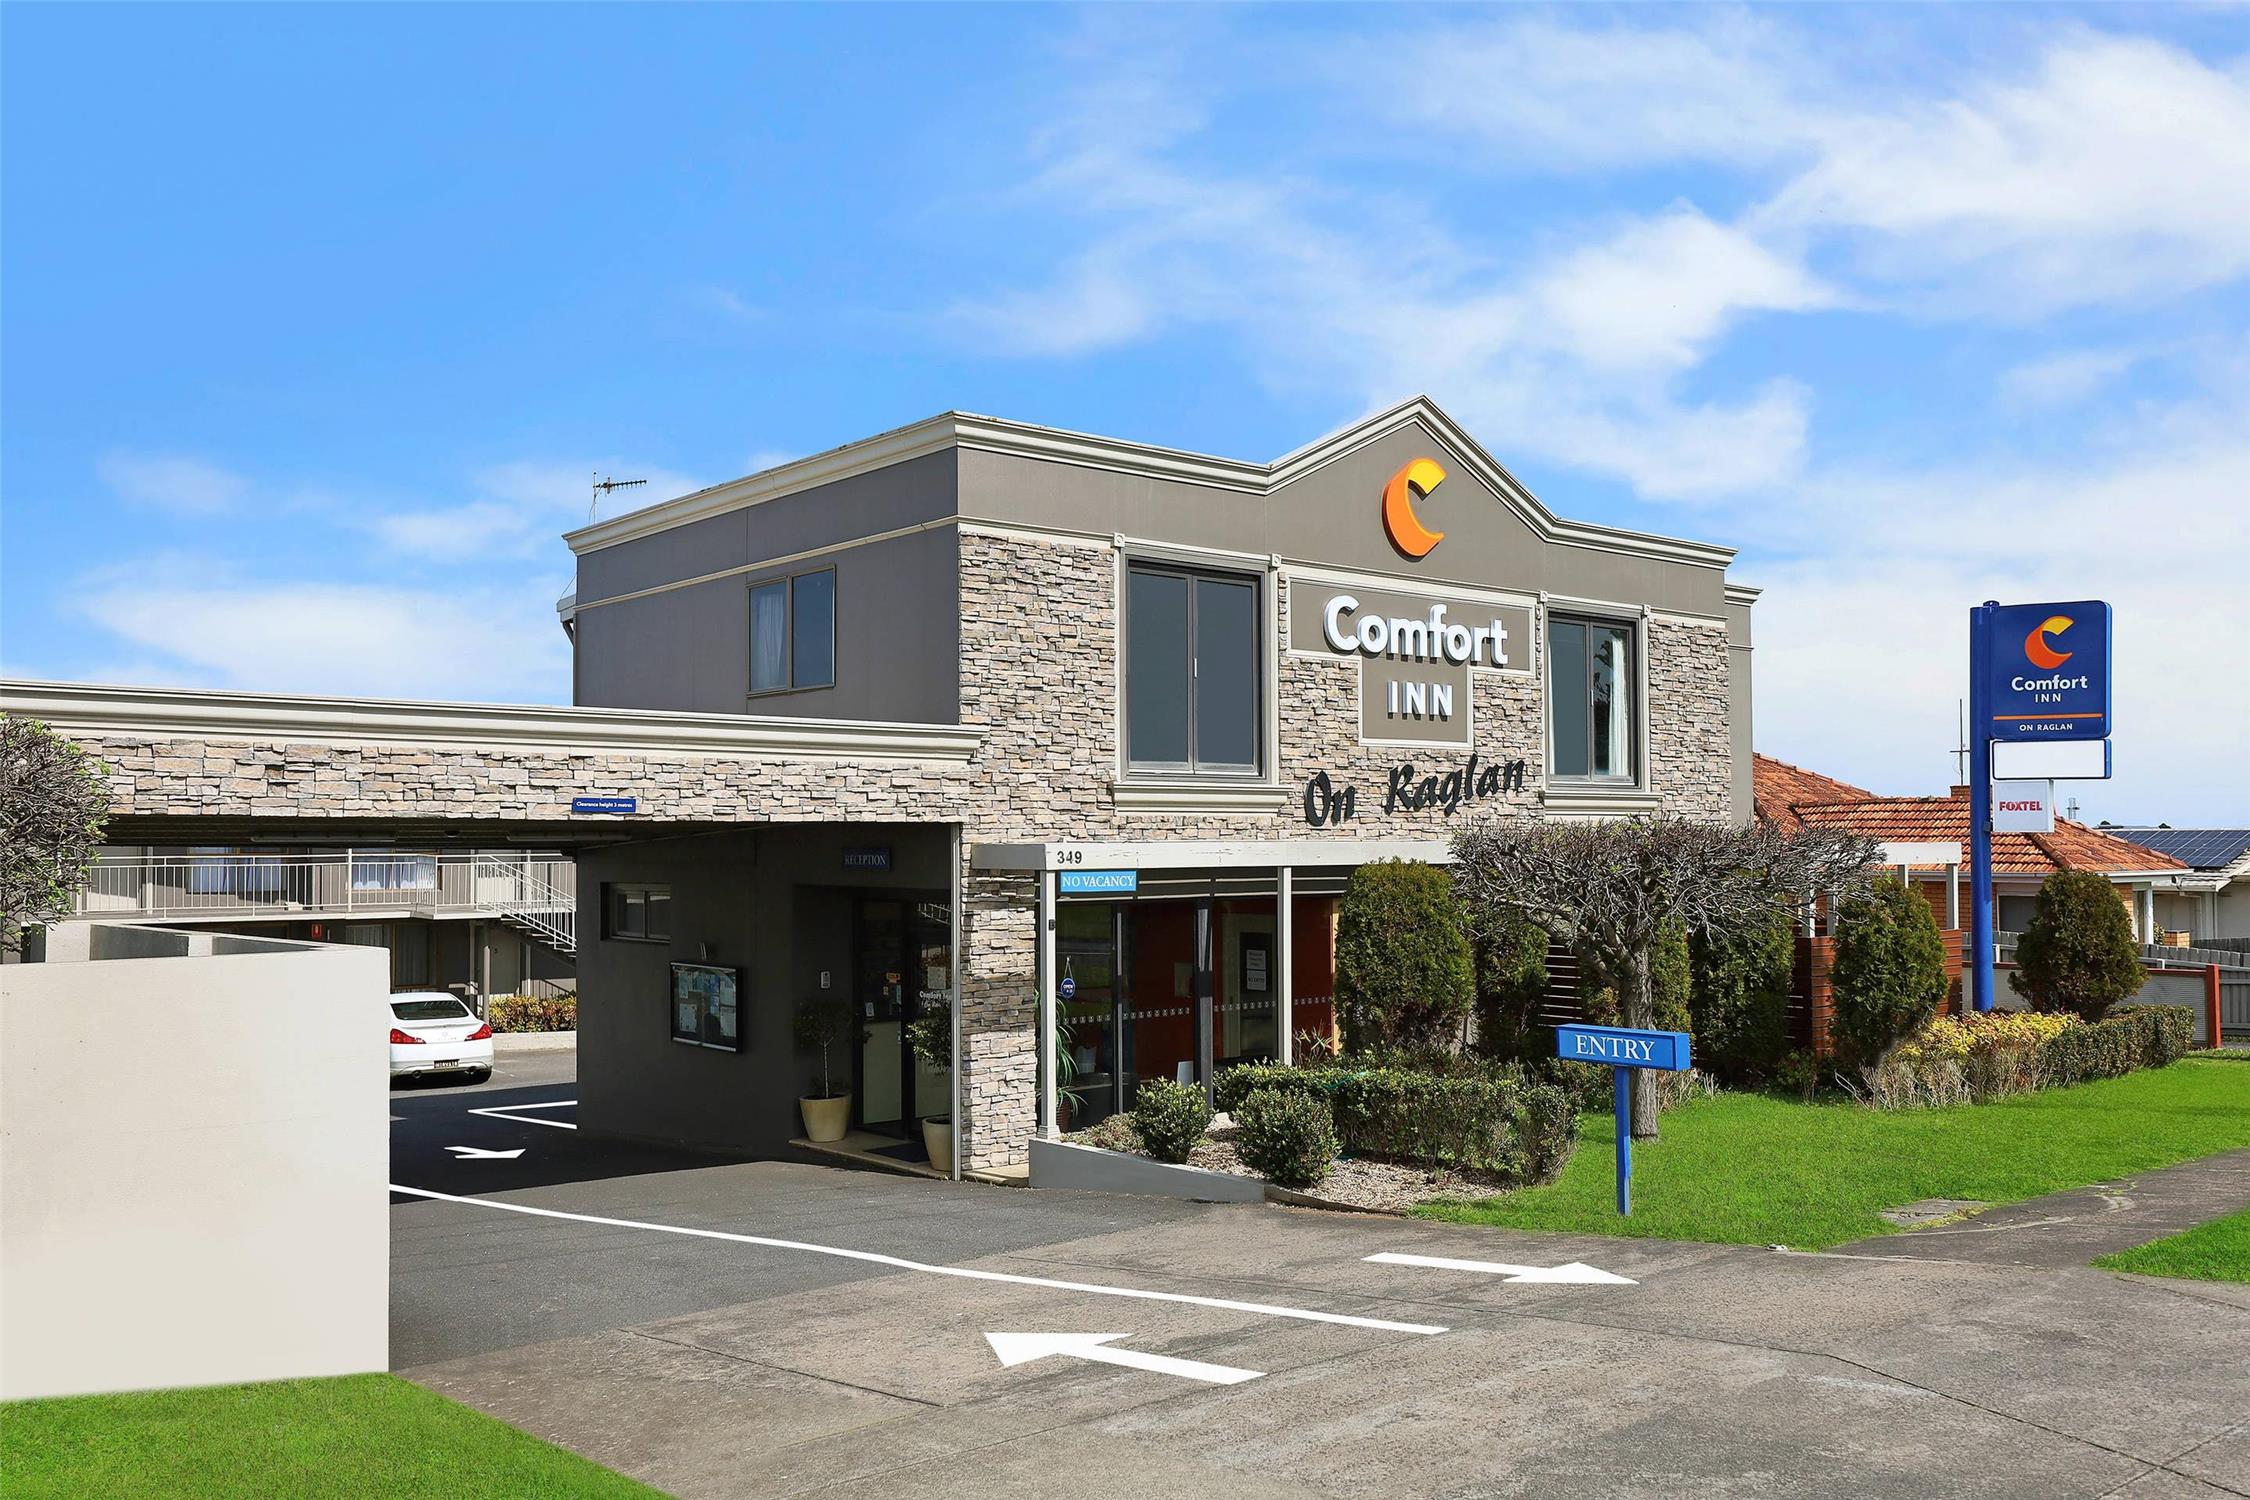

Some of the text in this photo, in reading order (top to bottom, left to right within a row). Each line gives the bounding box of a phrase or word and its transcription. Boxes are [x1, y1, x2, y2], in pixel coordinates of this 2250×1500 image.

[1324, 595, 1509, 665] Comfort
[2011, 674, 2088, 691] Comfort
[1388, 680, 1453, 716] INN
[2035, 693, 2062, 703] INN
[2019, 723, 2073, 732] ON RAGLAN
[1304, 752, 1525, 827] On Raglan
[1999, 801, 2042, 811] FOXTEL
[844, 854, 888, 866] RECEPTION
[1057, 850, 1083, 865] 349
[1062, 875, 1135, 887] NO VACANCY
[1575, 1034, 1655, 1061] ENTRY
